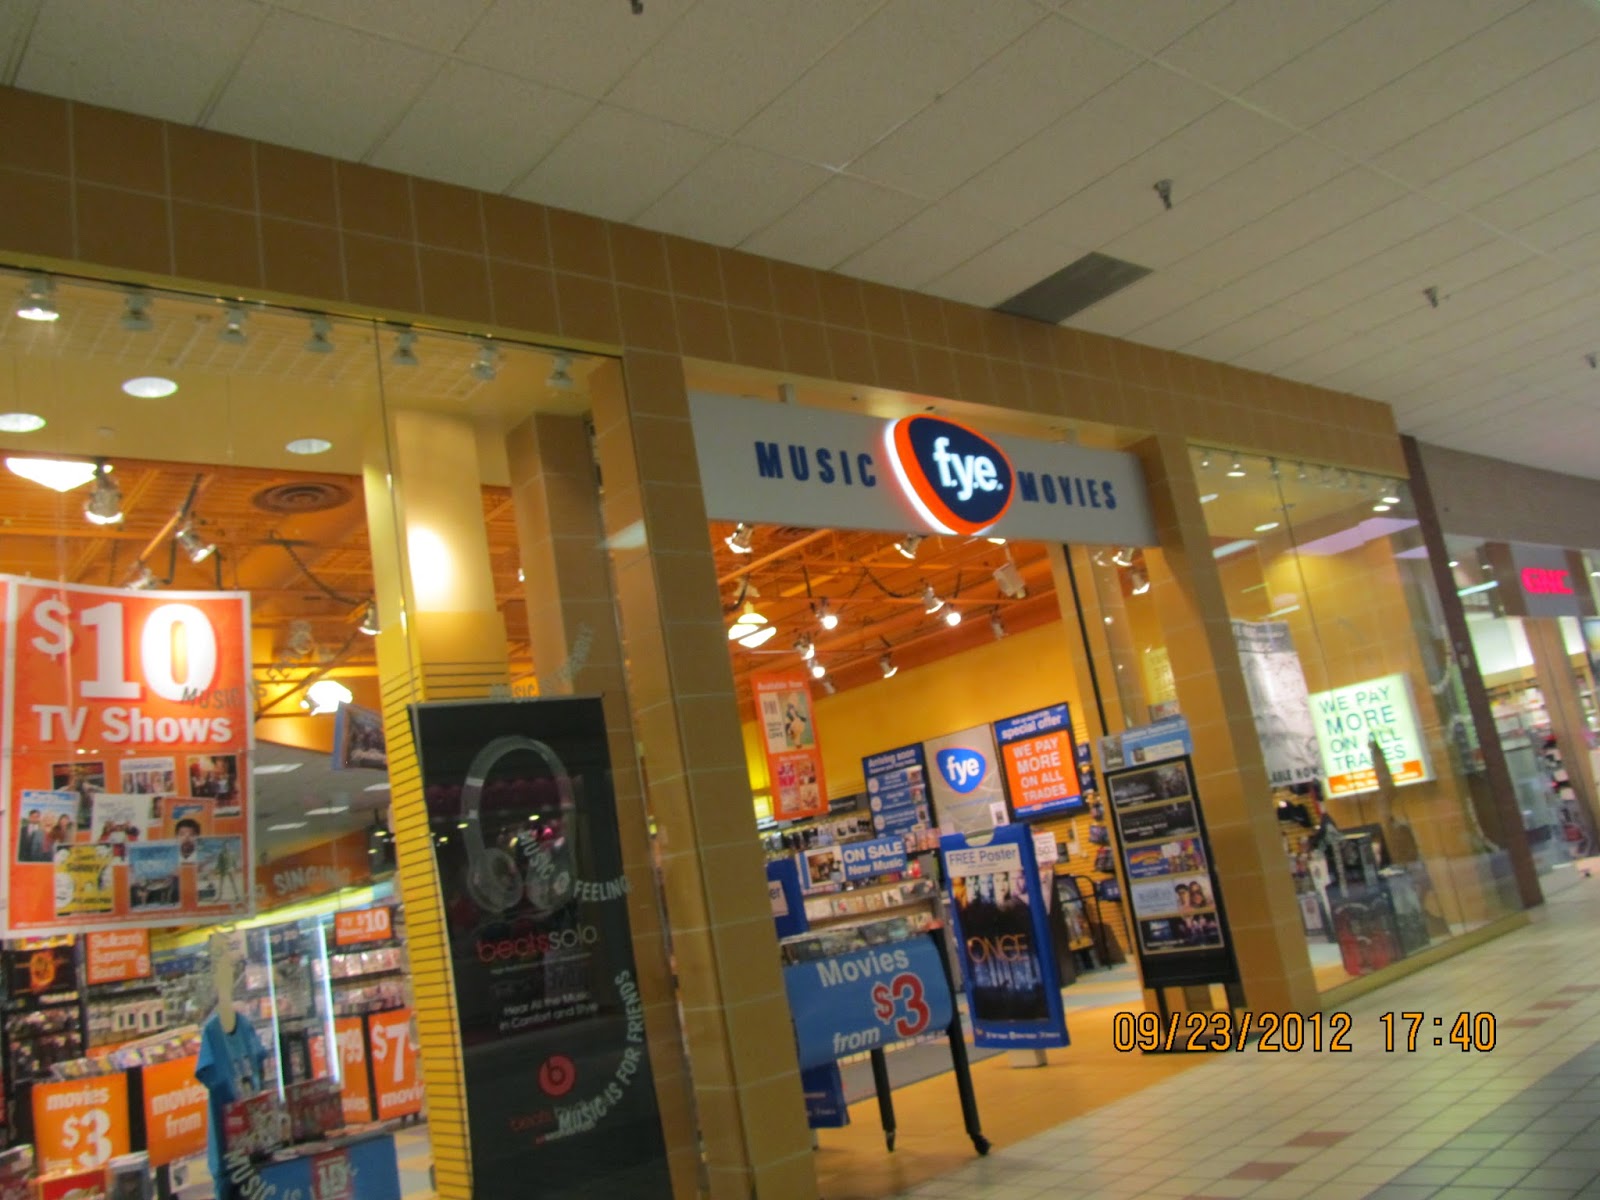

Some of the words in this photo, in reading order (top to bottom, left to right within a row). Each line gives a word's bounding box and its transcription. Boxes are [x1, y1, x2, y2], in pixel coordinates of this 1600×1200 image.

[754, 441, 877, 488] MUSIC
[1017, 471, 1117, 510] MOVIES
[31, 594, 218, 702] $10
[1320, 695, 1349, 714] WE
[1355, 685, 1391, 706] PAY
[31, 704, 89, 742] TV
[101, 706, 234, 744] Shows
[1325, 705, 1396, 736] MORE
[1013, 743, 1033, 759] WE
[1035, 737, 1059, 753] PAY
[1330, 738, 1359, 754] ON
[1333, 743, 1407, 770] TRAES
[1017, 751, 1061, 775] MORE
[1021, 775, 1038, 788] ON
[1042, 770, 1064, 784] ALL
[1023, 783, 1068, 803] TRADES
[843, 848, 866, 863] ON
[867, 841, 904, 859] SALE
[948, 852, 977, 866] FREE
[979, 847, 1017, 863] Poster
[847, 864, 871, 876] New
[873, 858, 904, 872] Music
[816, 949, 910, 988] Movies
[614, 969, 644, 1043] FRIENDS
[871, 973, 930, 1037] $3
[832, 1027, 880, 1055] from
[615, 1046, 642, 1086] FOR
[46, 1083, 111, 1112] movies
[61, 1108, 113, 1168] $3
[165, 1111, 202, 1139] from
